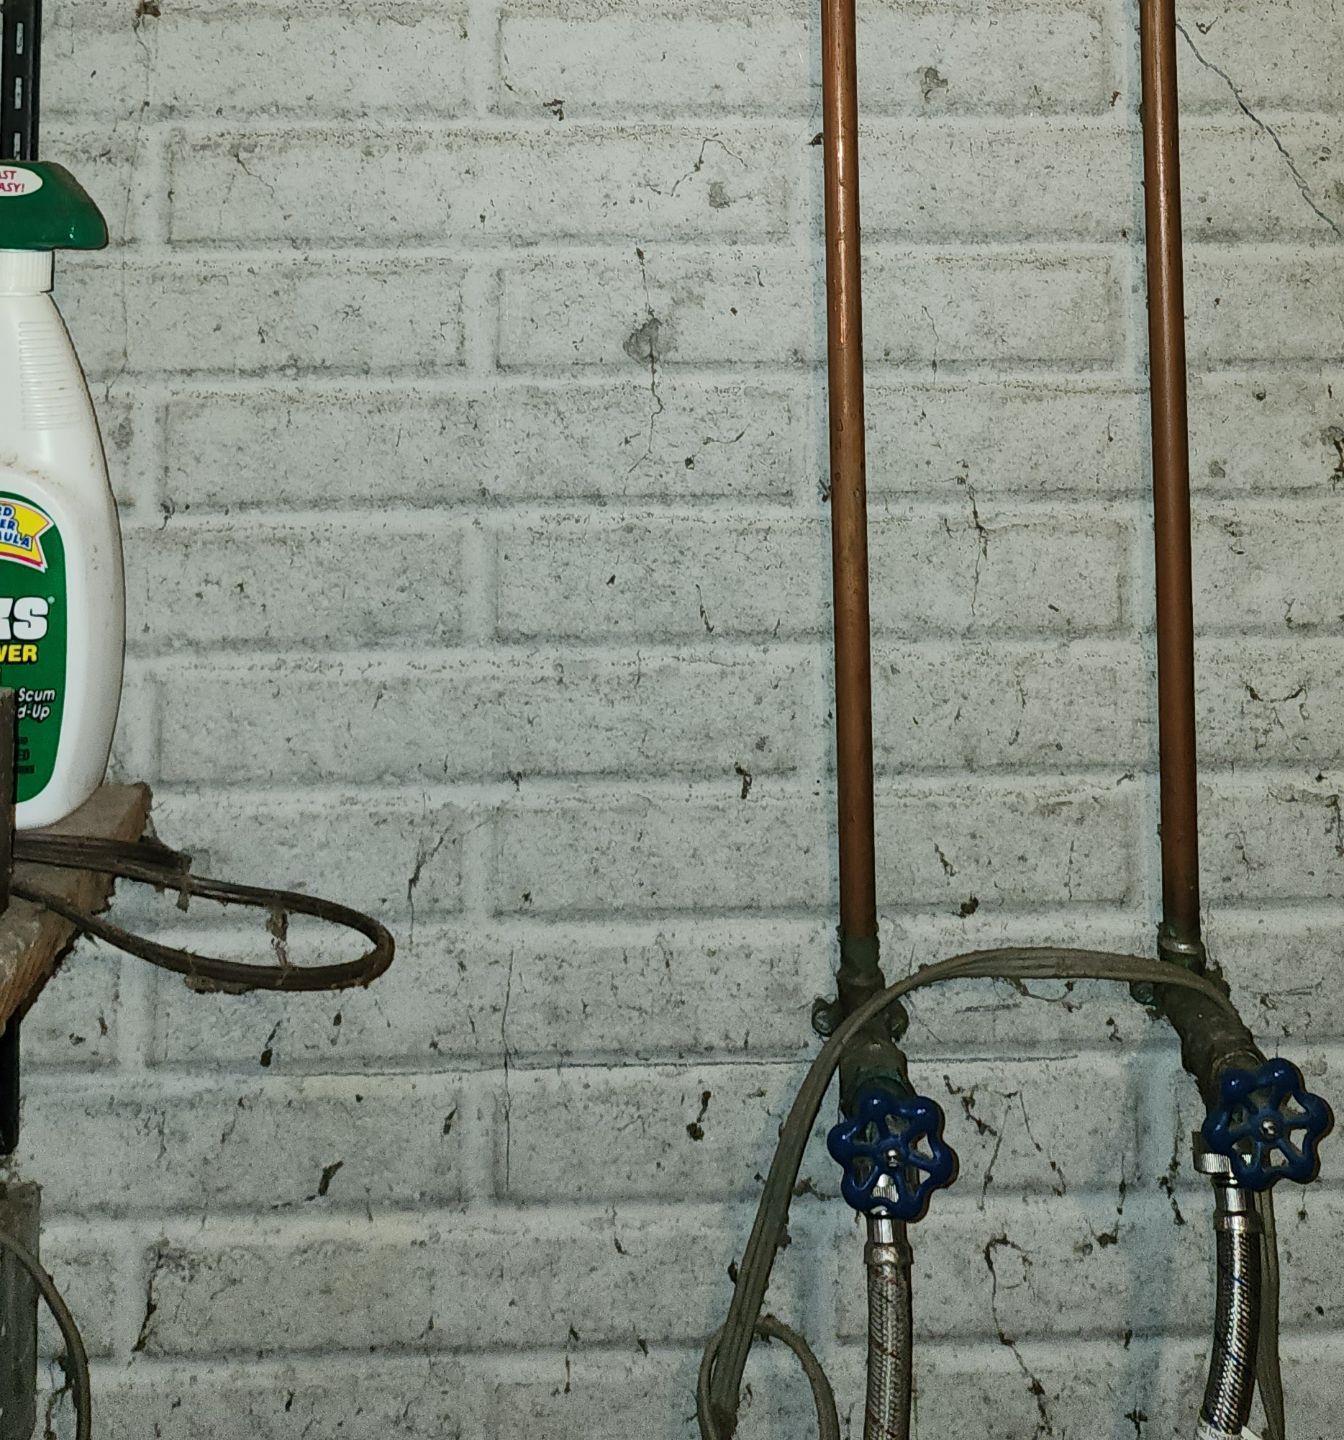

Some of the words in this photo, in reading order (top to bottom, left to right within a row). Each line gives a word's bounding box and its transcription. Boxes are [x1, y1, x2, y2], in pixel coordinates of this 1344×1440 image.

[0, 170, 17, 180] ST
[0, 506, 12, 516] D
[0, 531, 30, 548] ULA
[18, 687, 55, 702] Scum
